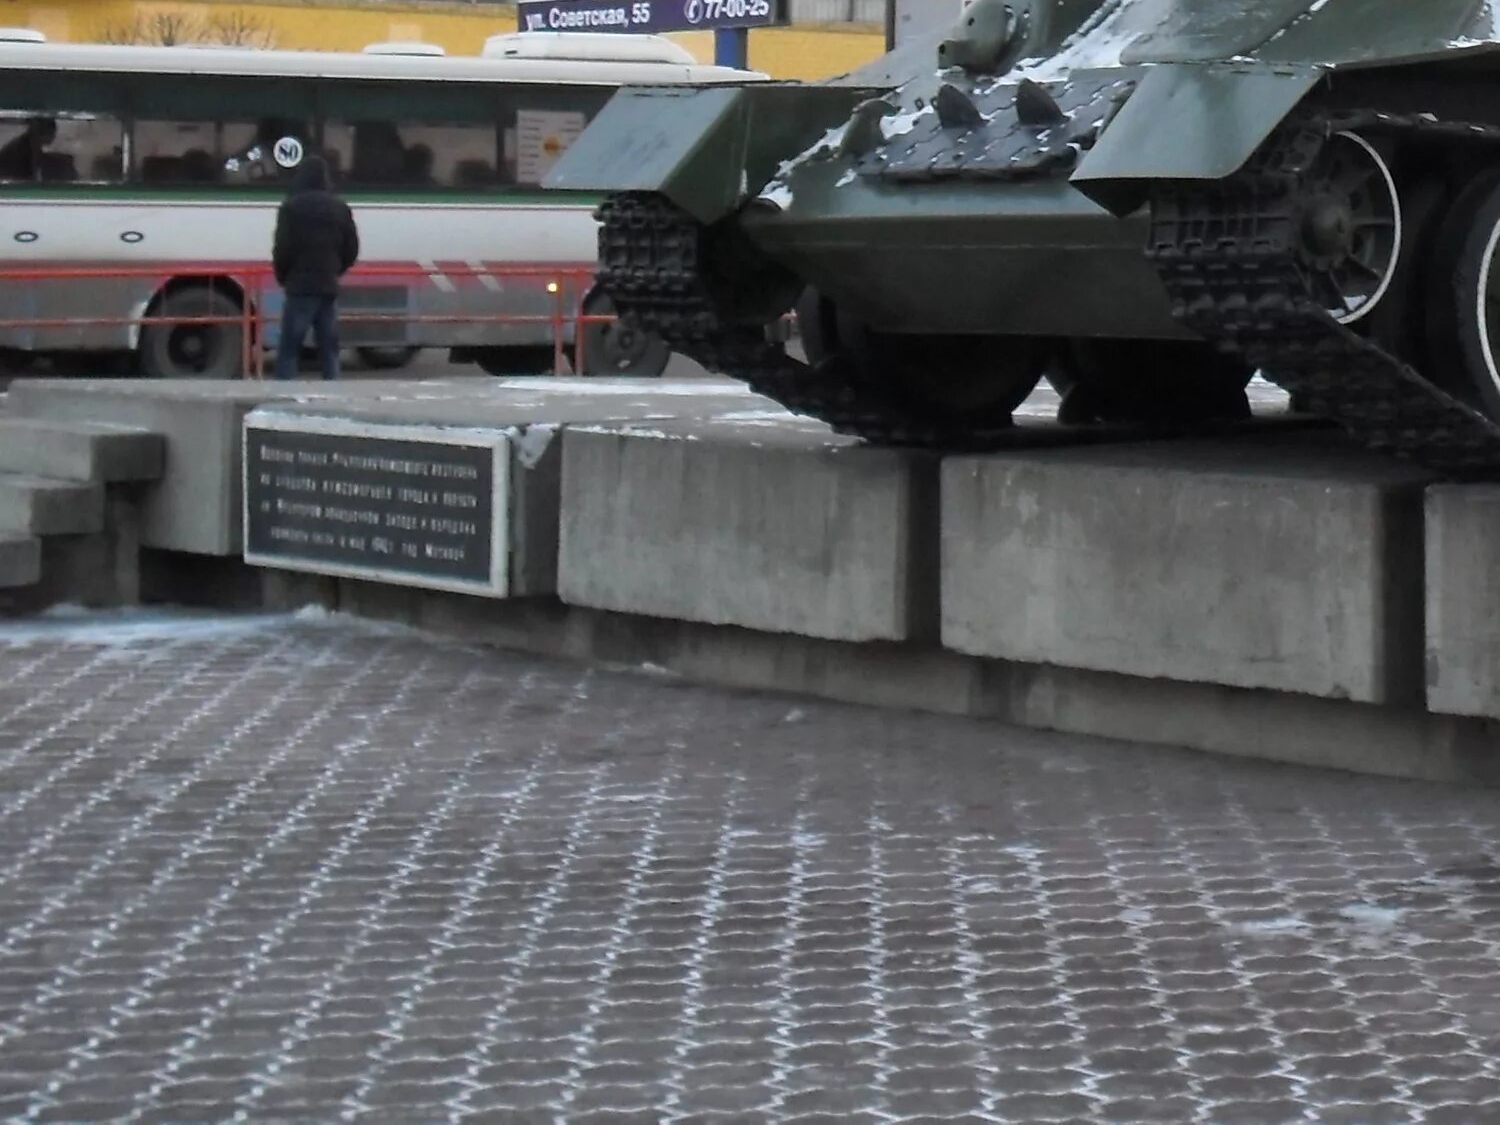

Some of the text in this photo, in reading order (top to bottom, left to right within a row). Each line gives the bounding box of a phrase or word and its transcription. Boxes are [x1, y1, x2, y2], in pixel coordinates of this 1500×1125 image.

[525, 2, 651, 32] ул. Советская, 55
